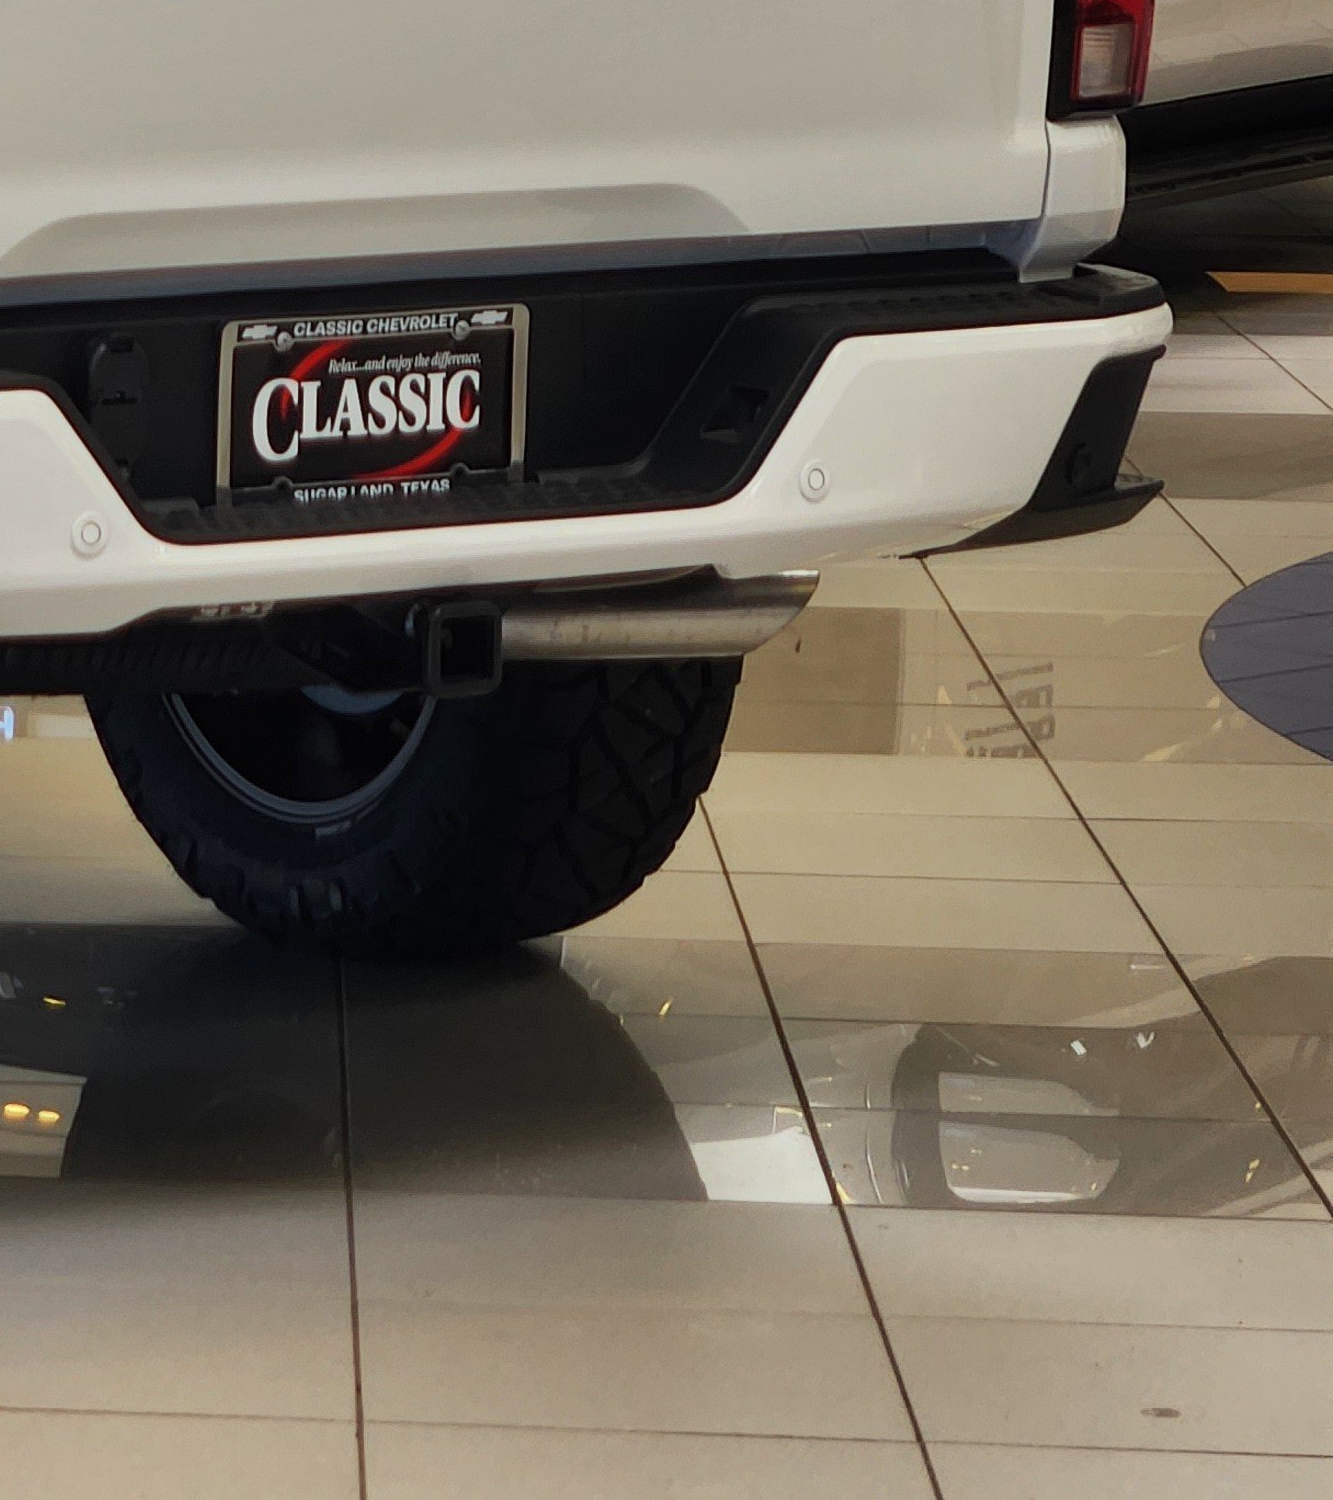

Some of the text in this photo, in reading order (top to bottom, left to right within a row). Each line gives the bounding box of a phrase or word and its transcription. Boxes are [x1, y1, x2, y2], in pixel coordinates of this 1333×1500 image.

[294, 312, 458, 338] CLASSIC CHEVROLET
[386, 353, 413, 373] enjoy
[414, 352, 430, 368] the
[252, 370, 481, 463] CLASSIC
